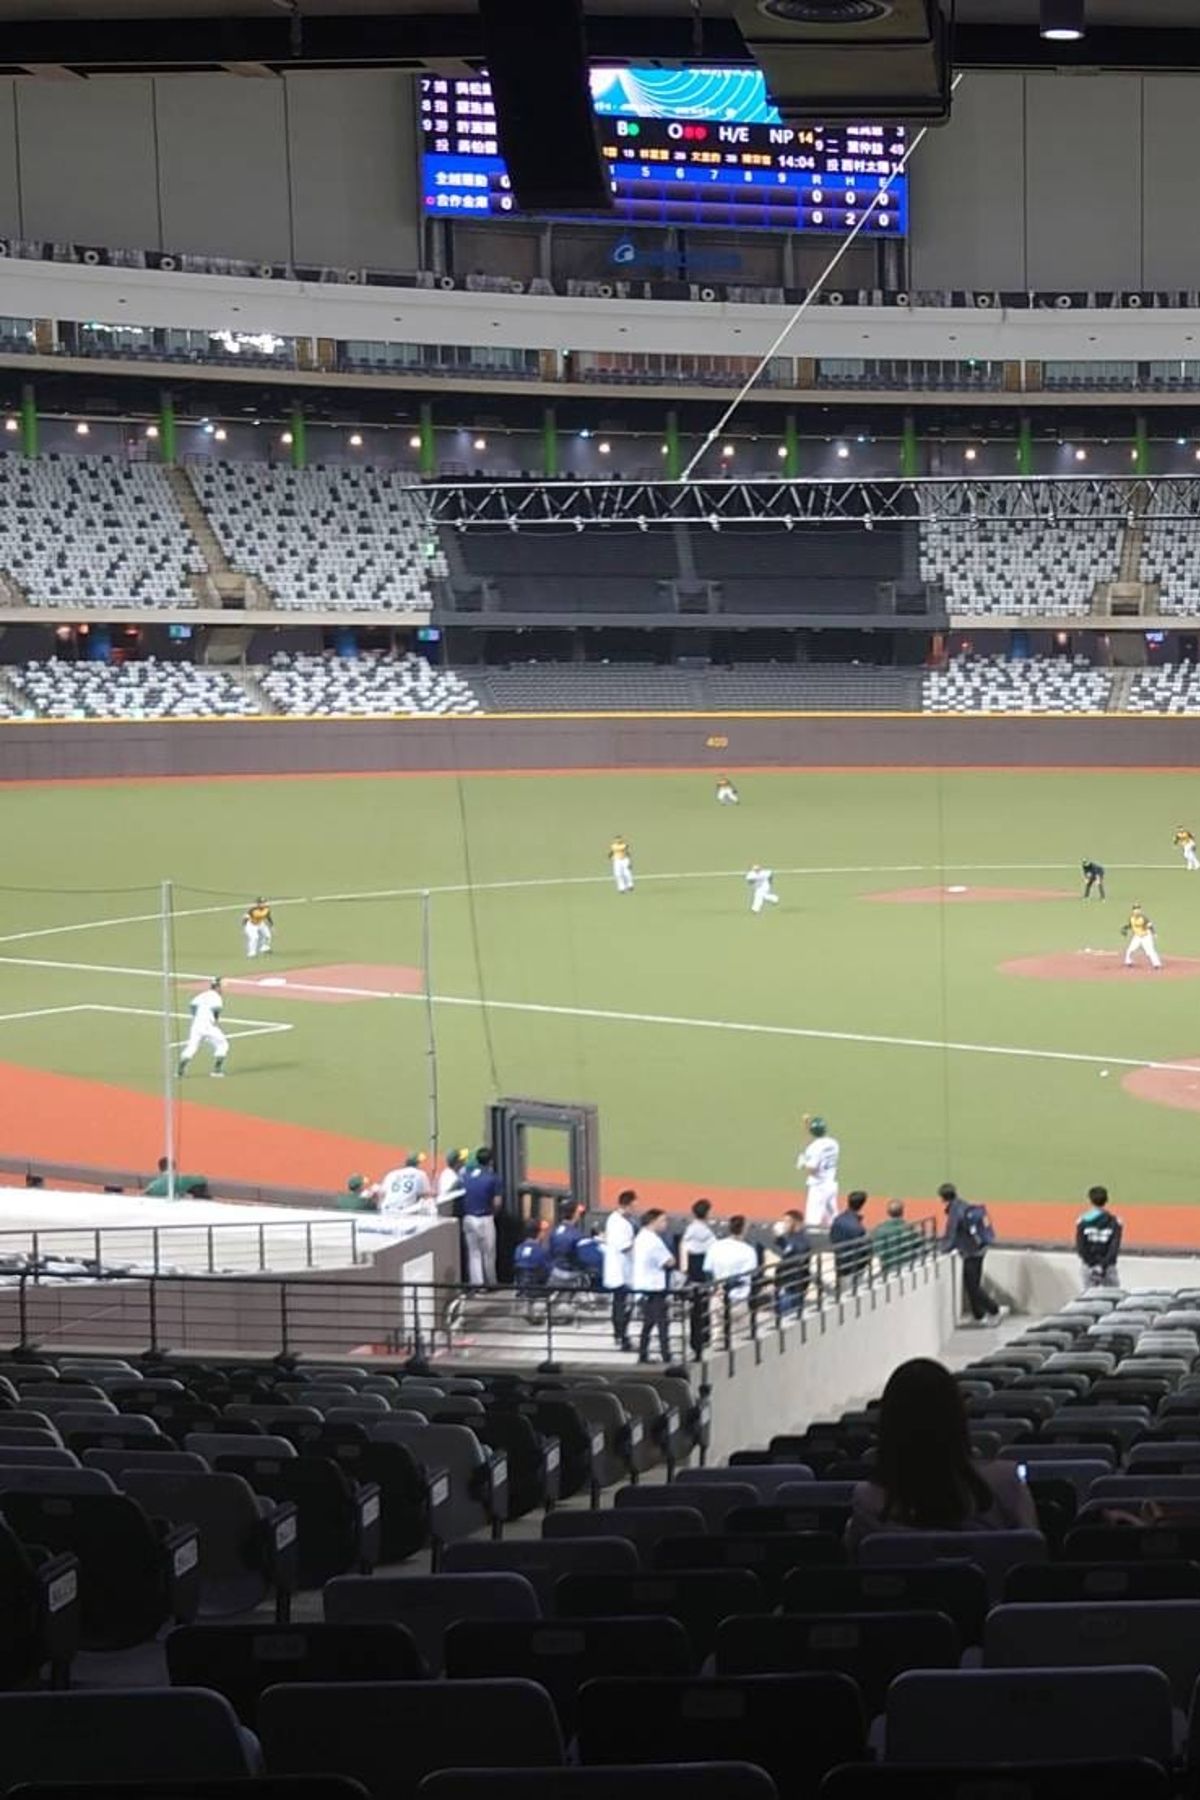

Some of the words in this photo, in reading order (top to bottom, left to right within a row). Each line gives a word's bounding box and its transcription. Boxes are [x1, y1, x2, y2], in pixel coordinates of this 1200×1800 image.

[421, 80, 430, 92] 7
[422, 119, 432, 131] 9
[616, 121, 628, 136] B
[719, 126, 750, 143] H/E
[769, 129, 794, 144] NP
[798, 132, 814, 144] 14
[777, 155, 815, 168] 14:04
[641, 166, 650, 177] 5
[676, 167, 685, 179] 6
[710, 169, 719, 180] 7
[812, 189, 822, 203] 0
[845, 191, 855, 204] 0
[500, 196, 512, 210] 0
[812, 211, 823, 224] 0
[845, 212, 856, 225] 2
[878, 213, 889, 227] 0
[391, 1180, 415, 1194] 69
